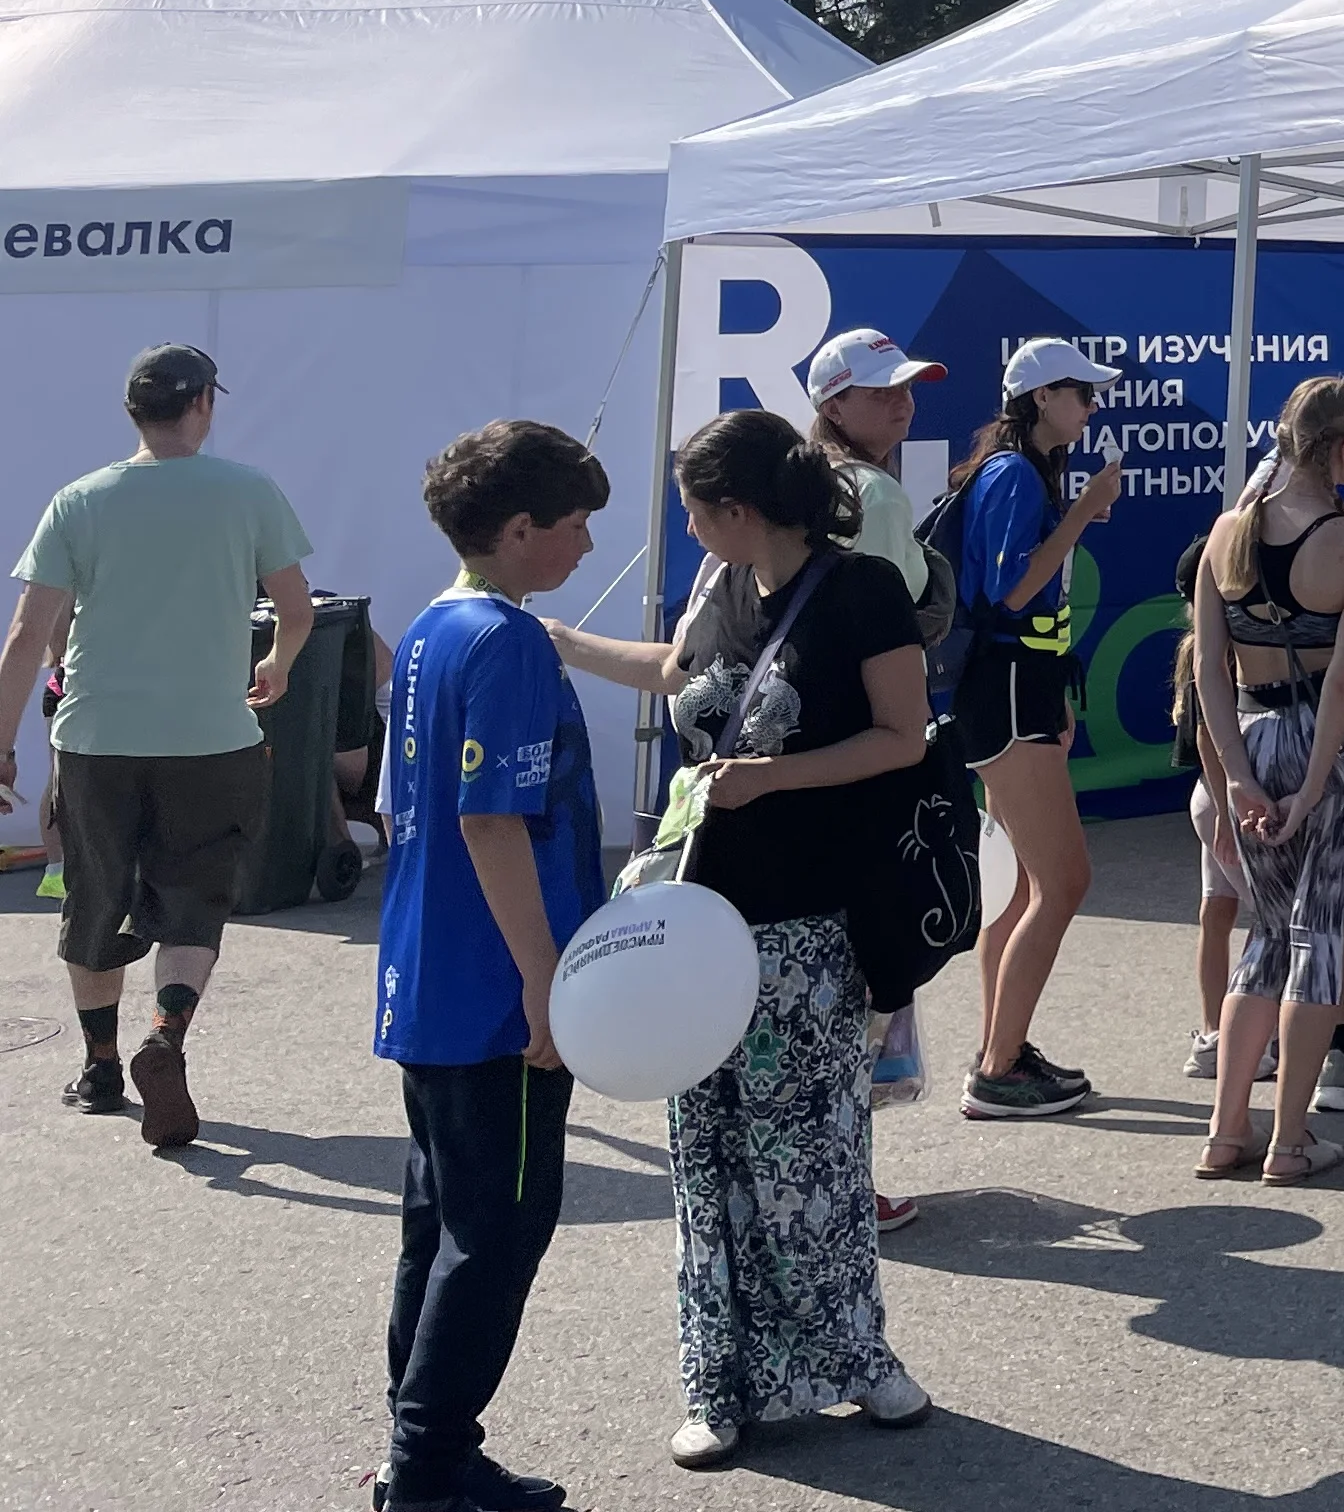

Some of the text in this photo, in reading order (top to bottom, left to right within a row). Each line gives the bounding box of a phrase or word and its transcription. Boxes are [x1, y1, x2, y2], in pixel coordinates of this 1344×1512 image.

[4, 218, 233, 259] евалка
[1138, 335, 1329, 364] ИЗУЧНИЯ
[656, 919, 666, 931] К
